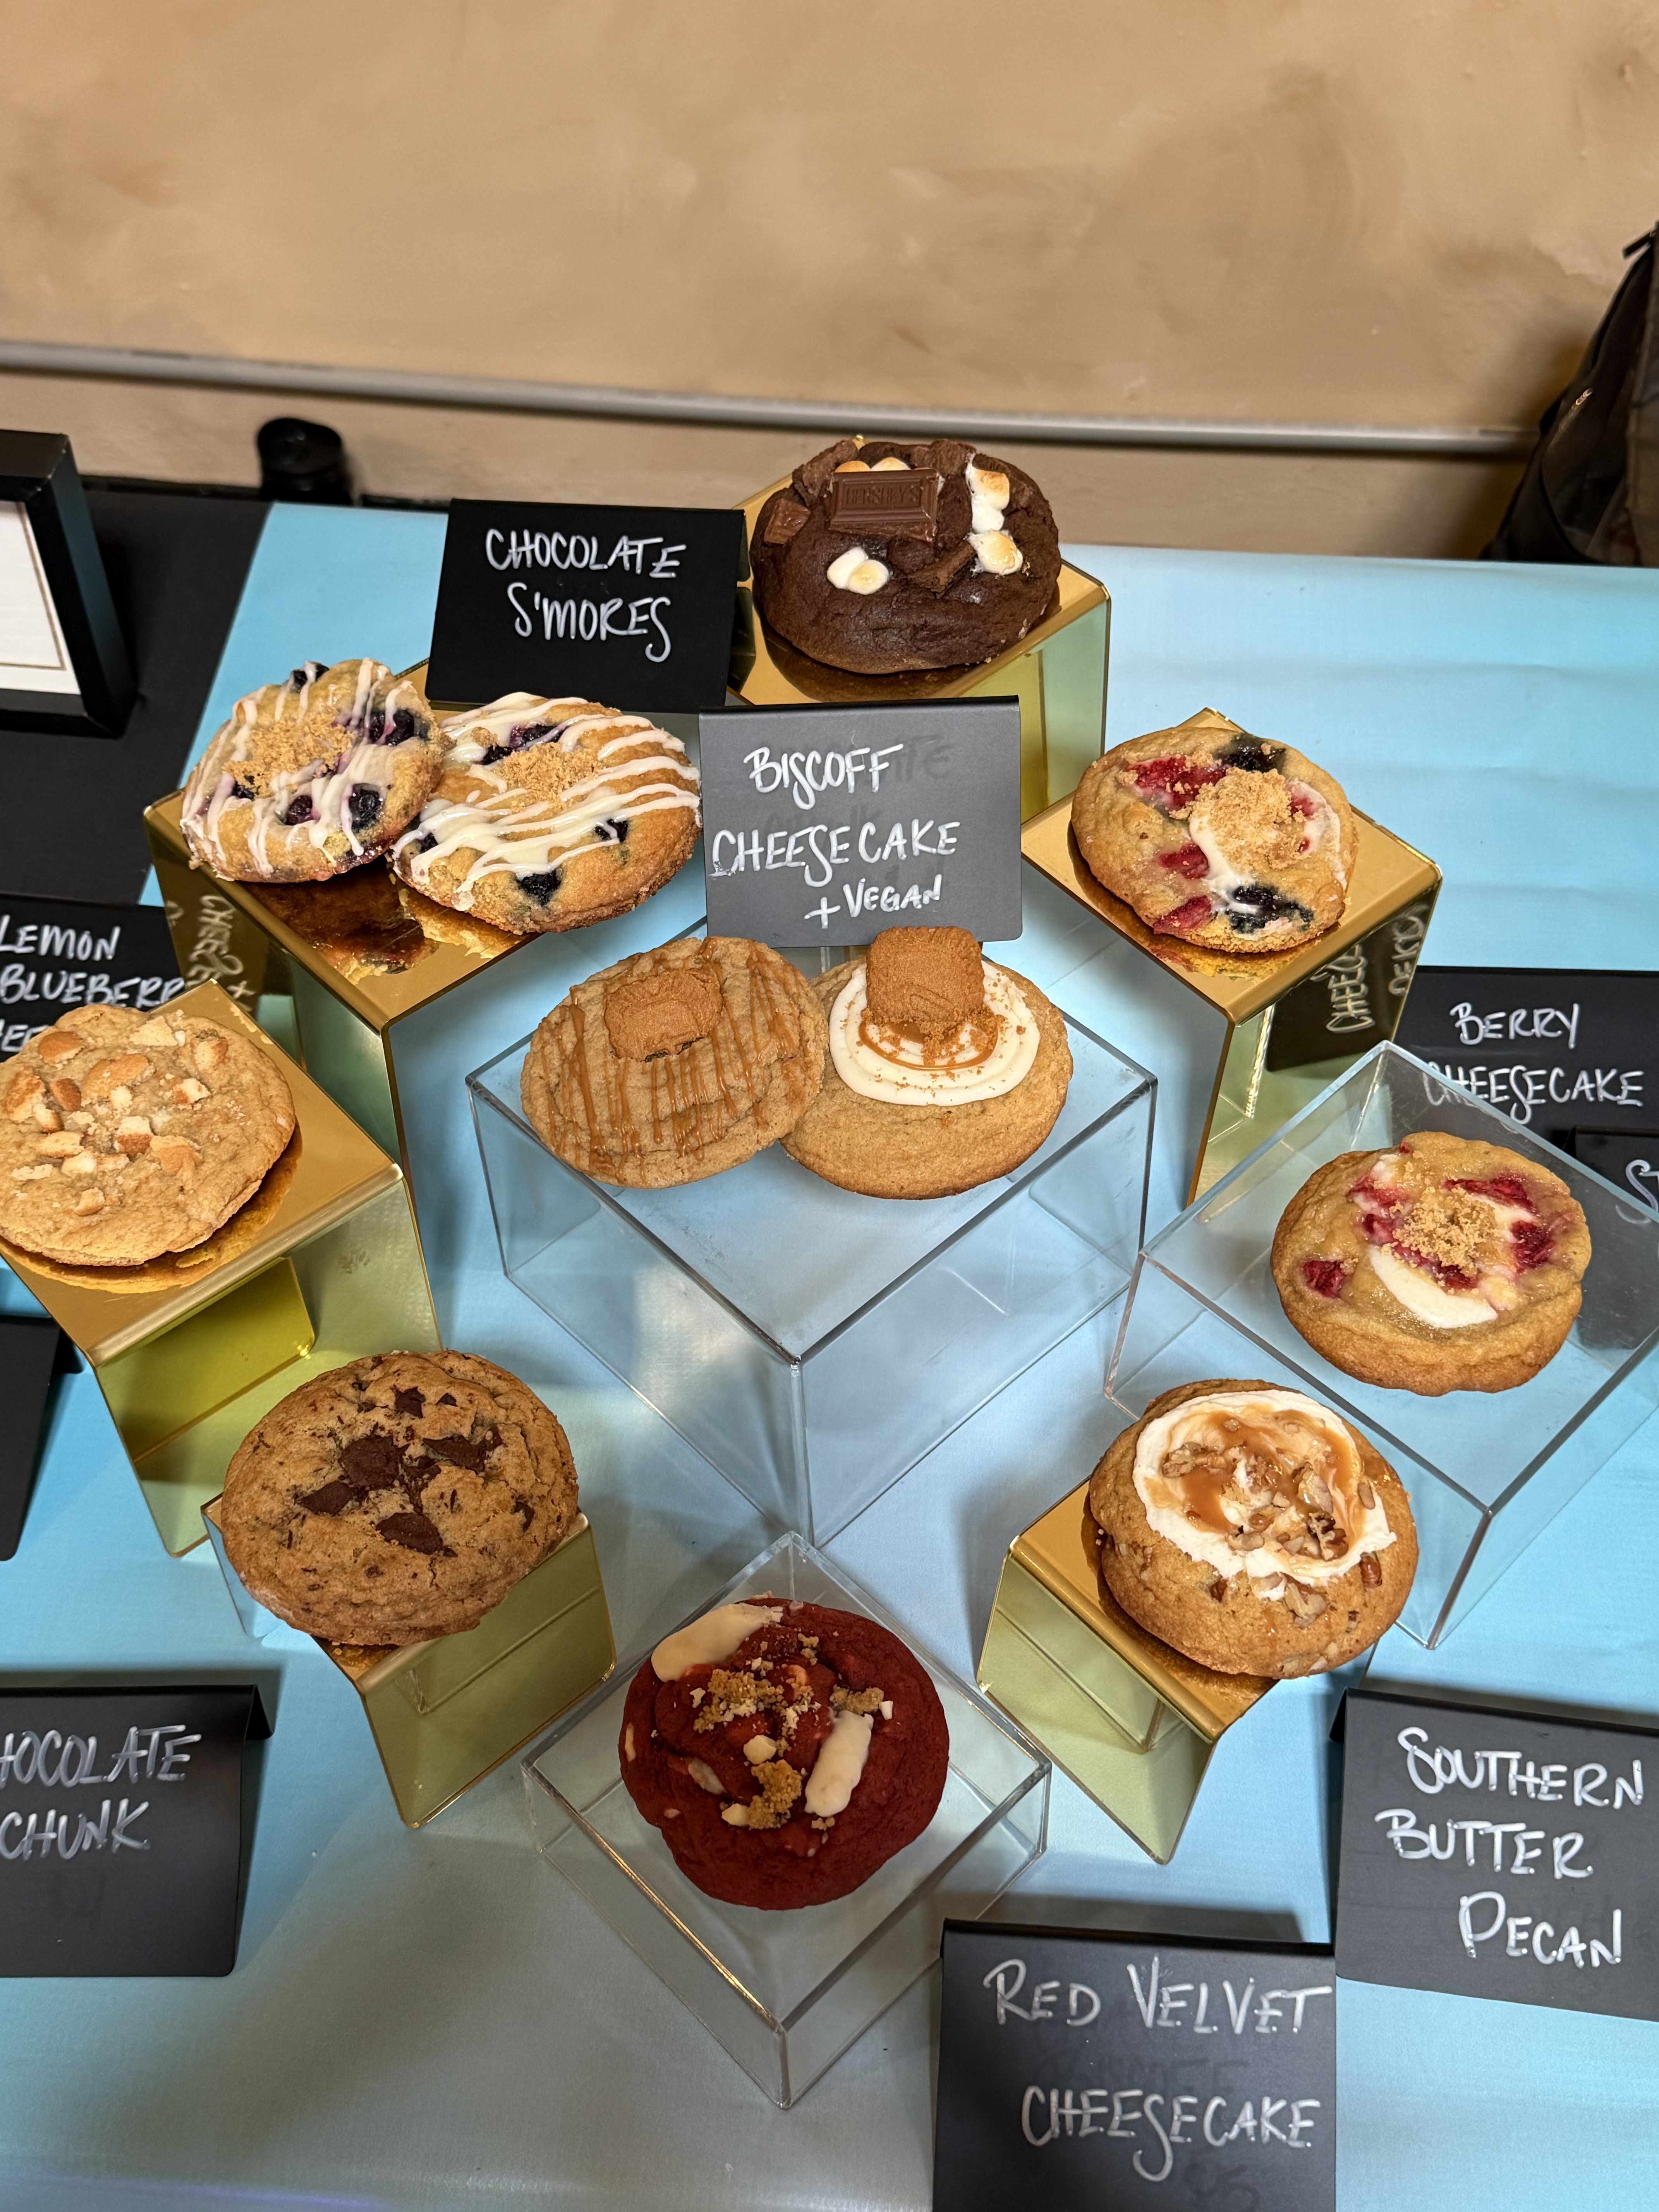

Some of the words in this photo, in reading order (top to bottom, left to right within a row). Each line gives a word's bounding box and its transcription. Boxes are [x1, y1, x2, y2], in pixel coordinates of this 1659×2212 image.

[486, 529, 687, 578] CHOCOLATE
[507, 582, 671, 663] S'MORES
[743, 744, 903, 810] BISCOFF
[0, 914, 121, 961] LEMON
[0, 963, 185, 1008] BLUEBERR
[1449, 1002, 1580, 1049] BERRY
[1421, 1061, 1644, 1125] CHEESECAKE
[0, 1724, 201, 1787] HOCOLATE
[1397, 1726, 1644, 1810] SOUTHERN
[0, 1798, 151, 1859] CHUNK
[1375, 1808, 1593, 1879] BUTTER
[1458, 1891, 1621, 1968] PECAN
[983, 1958, 1101, 2025] RED
[1127, 1956, 1333, 2035] VELVET
[1022, 2085, 1320, 2182] CHEESECAKE
